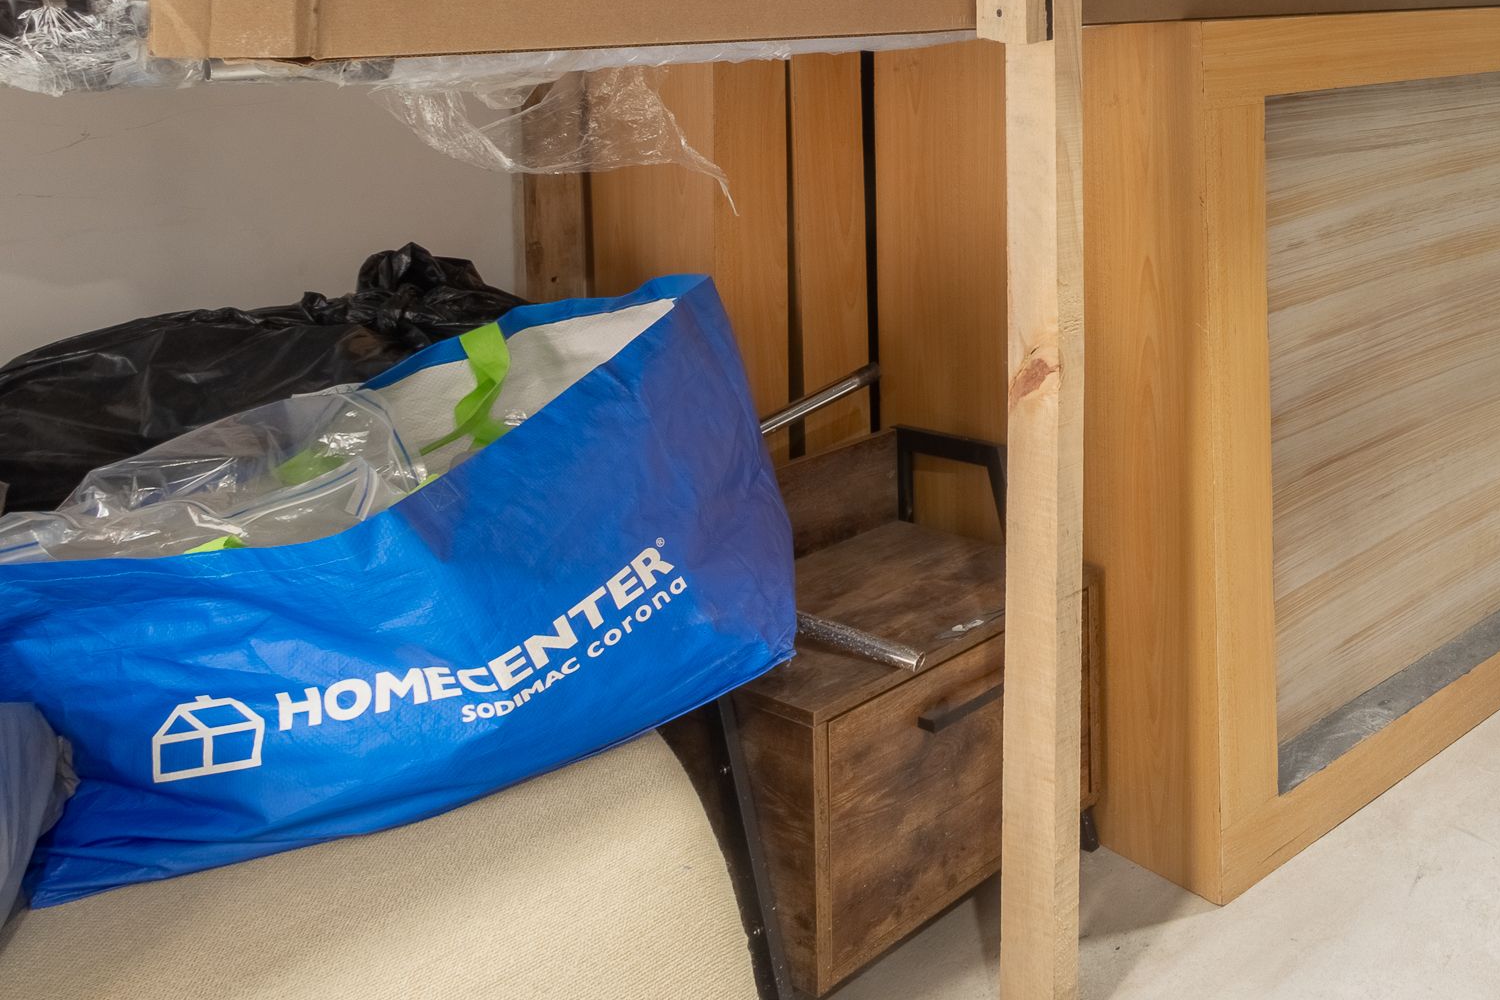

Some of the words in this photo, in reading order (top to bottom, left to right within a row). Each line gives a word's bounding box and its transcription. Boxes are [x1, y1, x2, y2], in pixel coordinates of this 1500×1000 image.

[275, 547, 675, 731] HOMECENTER
[461, 657, 581, 723] SODIMAC
[586, 576, 688, 658] corona
